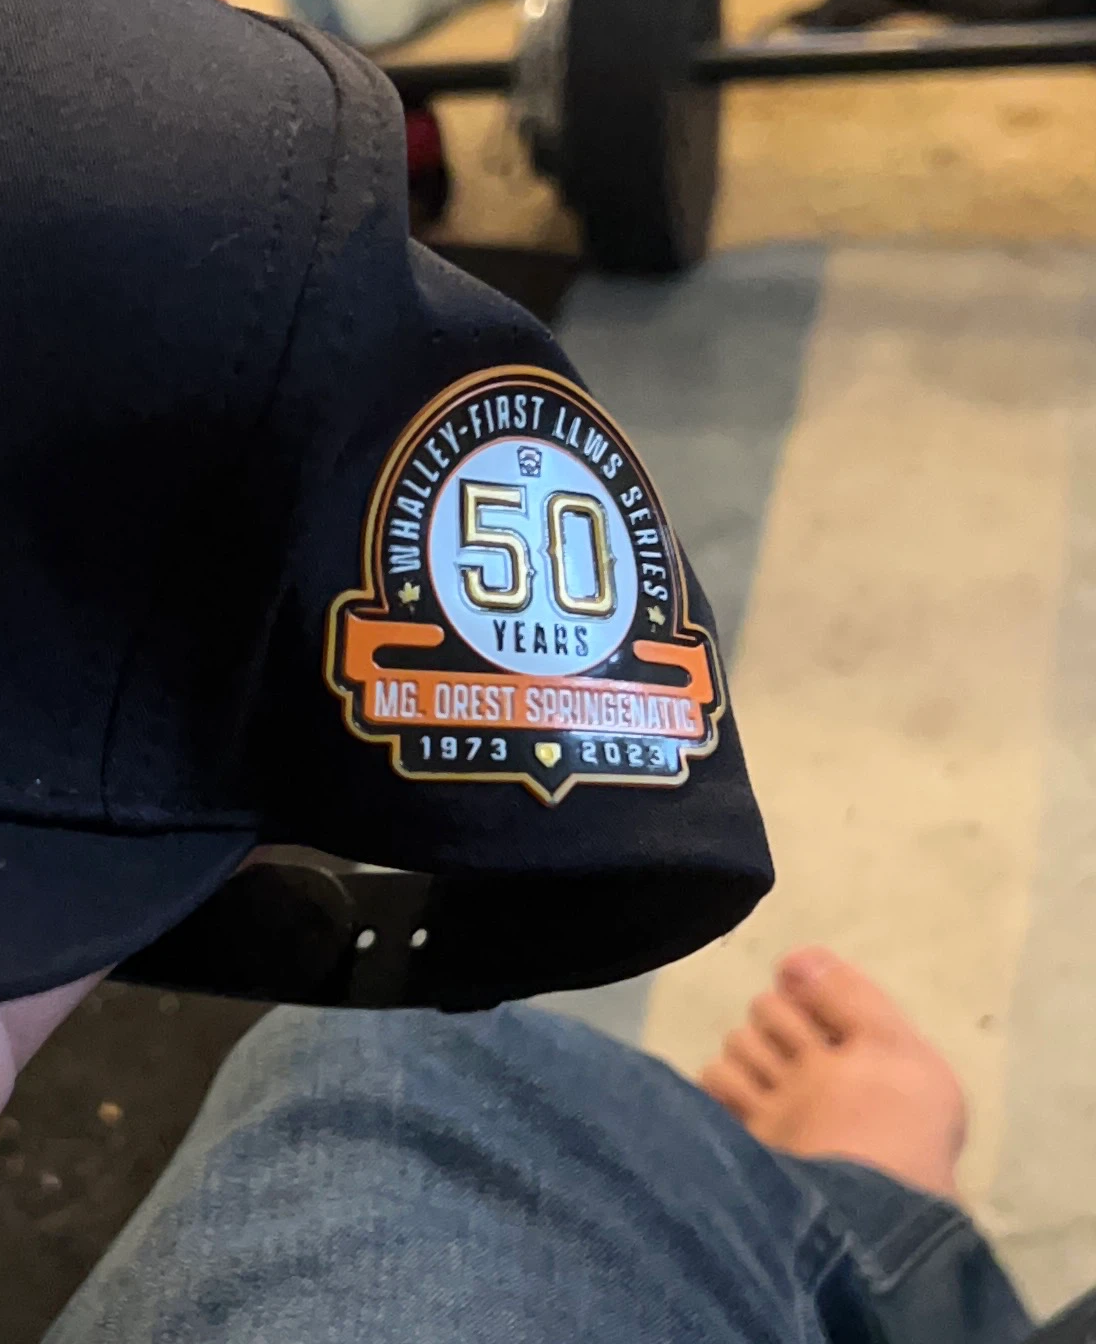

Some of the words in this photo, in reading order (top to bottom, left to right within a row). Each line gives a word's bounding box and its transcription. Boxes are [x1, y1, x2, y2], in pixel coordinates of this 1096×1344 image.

[388, 393, 545, 575] WHALLEY-FIRST
[551, 406, 624, 480] LLWS
[619, 484, 669, 603] SERIES
[456, 477, 617, 617] 50
[492, 619, 590, 657] YEARS
[373, 680, 427, 719] MG.
[434, 682, 516, 722] OREST
[525, 687, 696, 732] SPRINGENATIC
[419, 735, 509, 762] 1973
[581, 741, 667, 769] 2023
